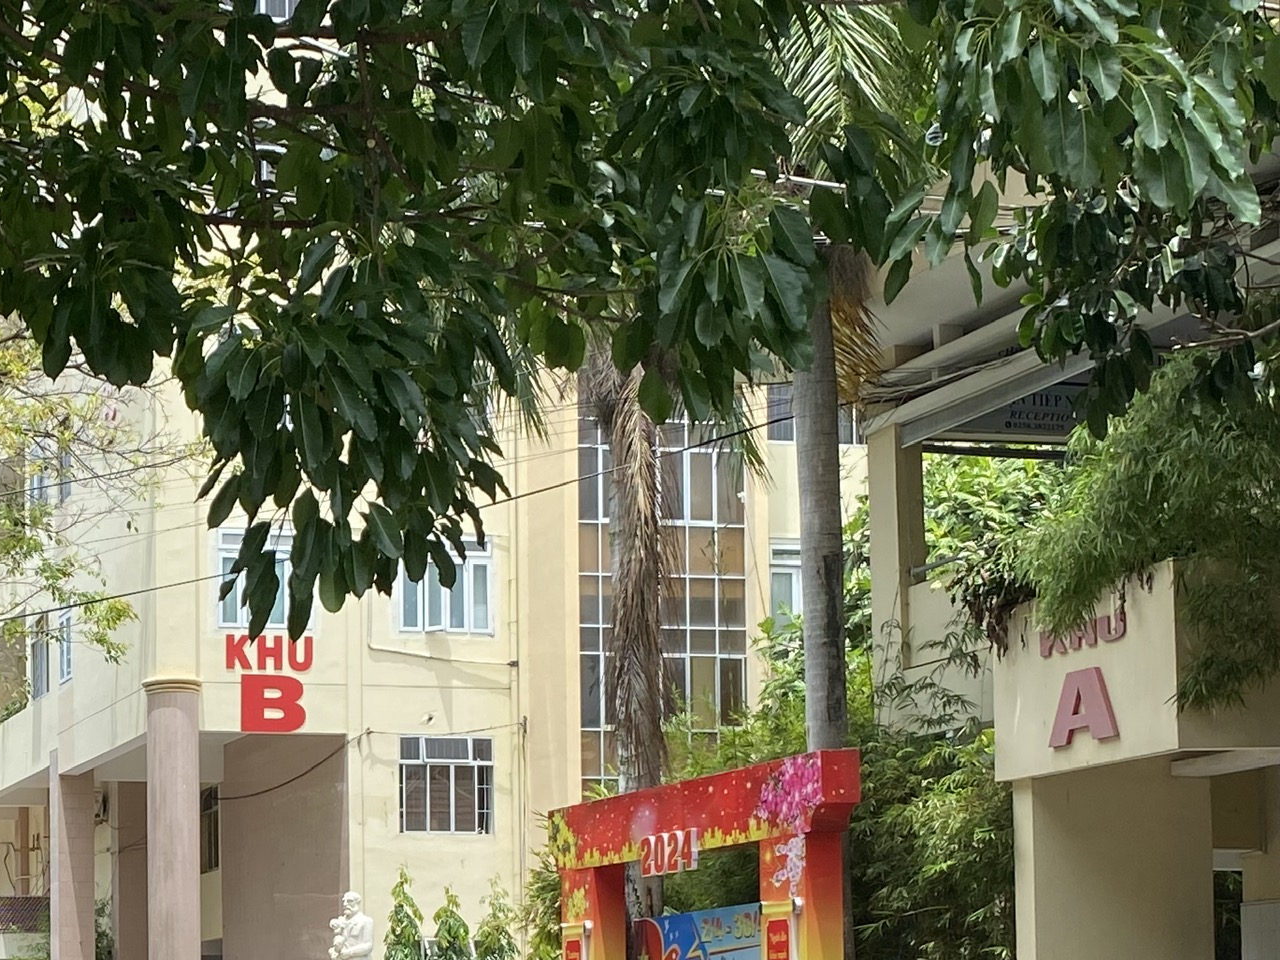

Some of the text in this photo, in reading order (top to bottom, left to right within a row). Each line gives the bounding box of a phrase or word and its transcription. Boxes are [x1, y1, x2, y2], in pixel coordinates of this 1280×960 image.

[1009, 411, 1070, 422] RECEPTIO
[225, 634, 313, 672] KHU
[240, 674, 306, 733] B
[1048, 667, 1120, 748] A
[640, 828, 698, 878] 2024
